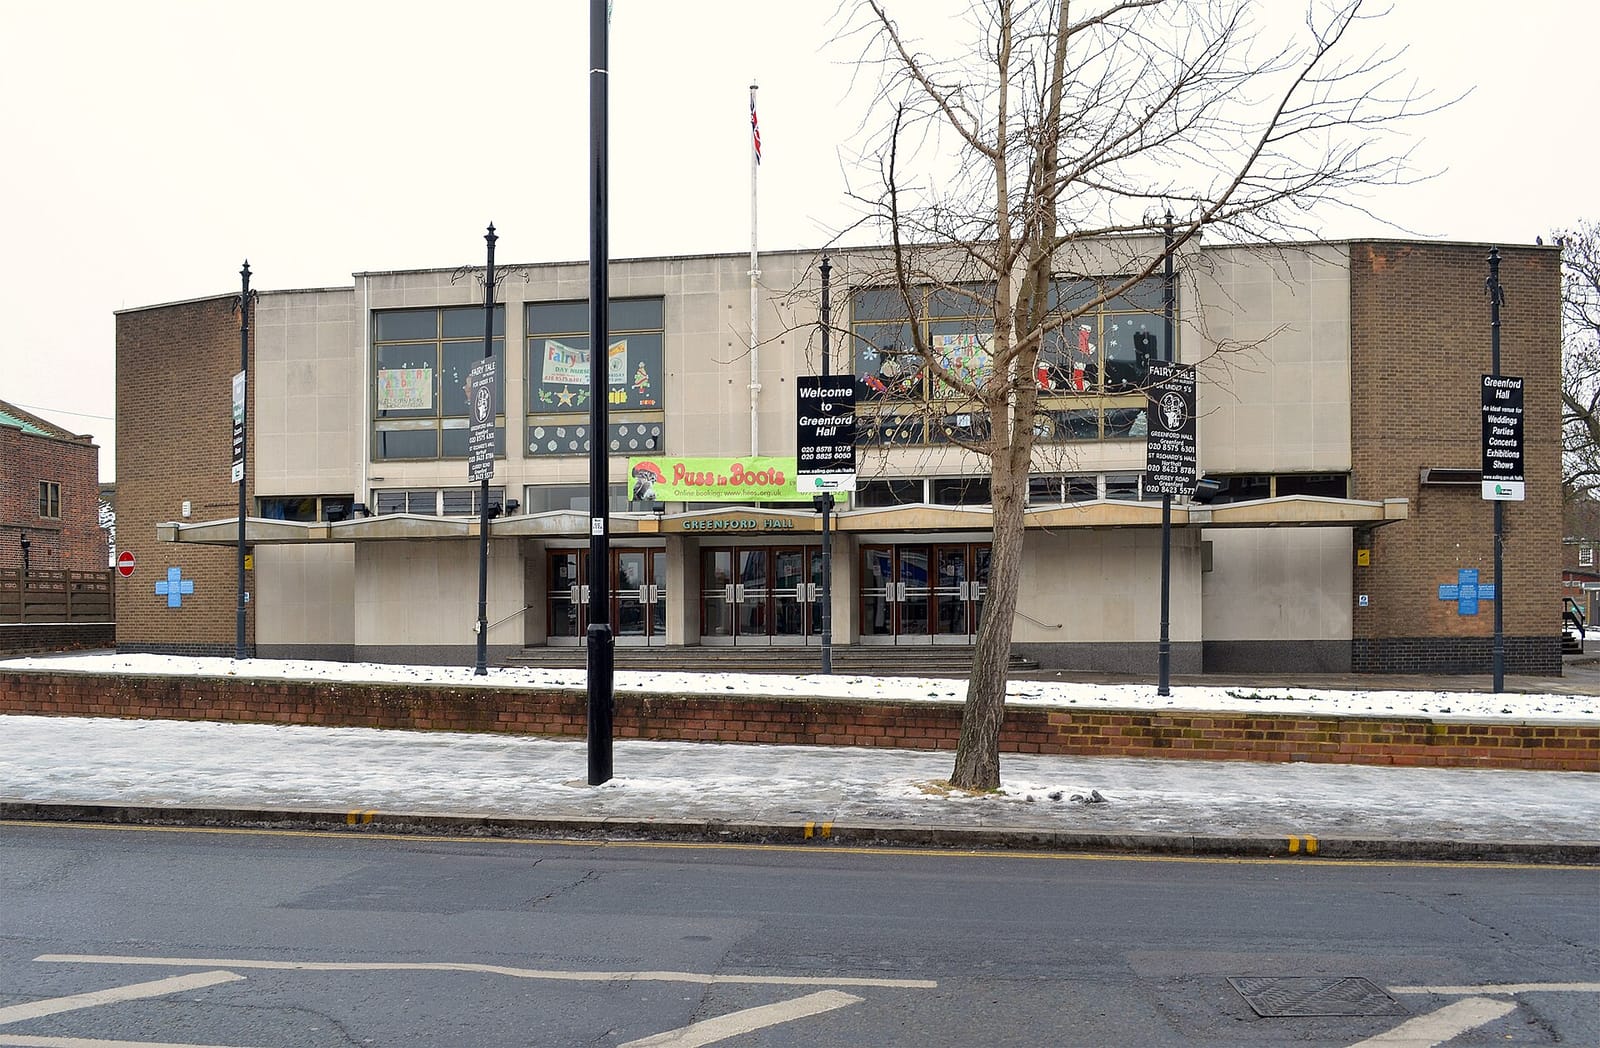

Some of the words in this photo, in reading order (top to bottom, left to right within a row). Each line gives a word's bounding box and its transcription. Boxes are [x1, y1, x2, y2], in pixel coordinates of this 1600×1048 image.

[548, 346, 576, 367] Fairy
[1150, 366, 1174, 377] FAIRY
[1175, 370, 1194, 380] TALE
[1484, 376, 1522, 389] Greenford
[800, 387, 853, 398] Welcome
[1496, 389, 1510, 400] Hall
[821, 402, 832, 412] to
[800, 416, 853, 426] Greenford
[1488, 414, 1518, 426] Weddings
[816, 426, 836, 436] Hall
[1150, 430, 1180, 439] GREENFORD
[1492, 426, 1514, 436] Parties
[1148, 442, 1162, 450] 020
[1160, 438, 1184, 446] Greenford
[1488, 437, 1518, 447] Concerts
[1486, 449, 1520, 459] Exhibitions
[1148, 464, 1160, 472] 020
[1492, 460, 1514, 470] Shows
[672, 463, 714, 486] Puss
[717, 474, 728, 486] in
[730, 463, 786, 486] Boots
[1158, 480, 1184, 488] Greenford
[1160, 486, 1178, 494] 8423
[682, 519, 758, 530] GREENFORD
[764, 518, 795, 530] HALL
